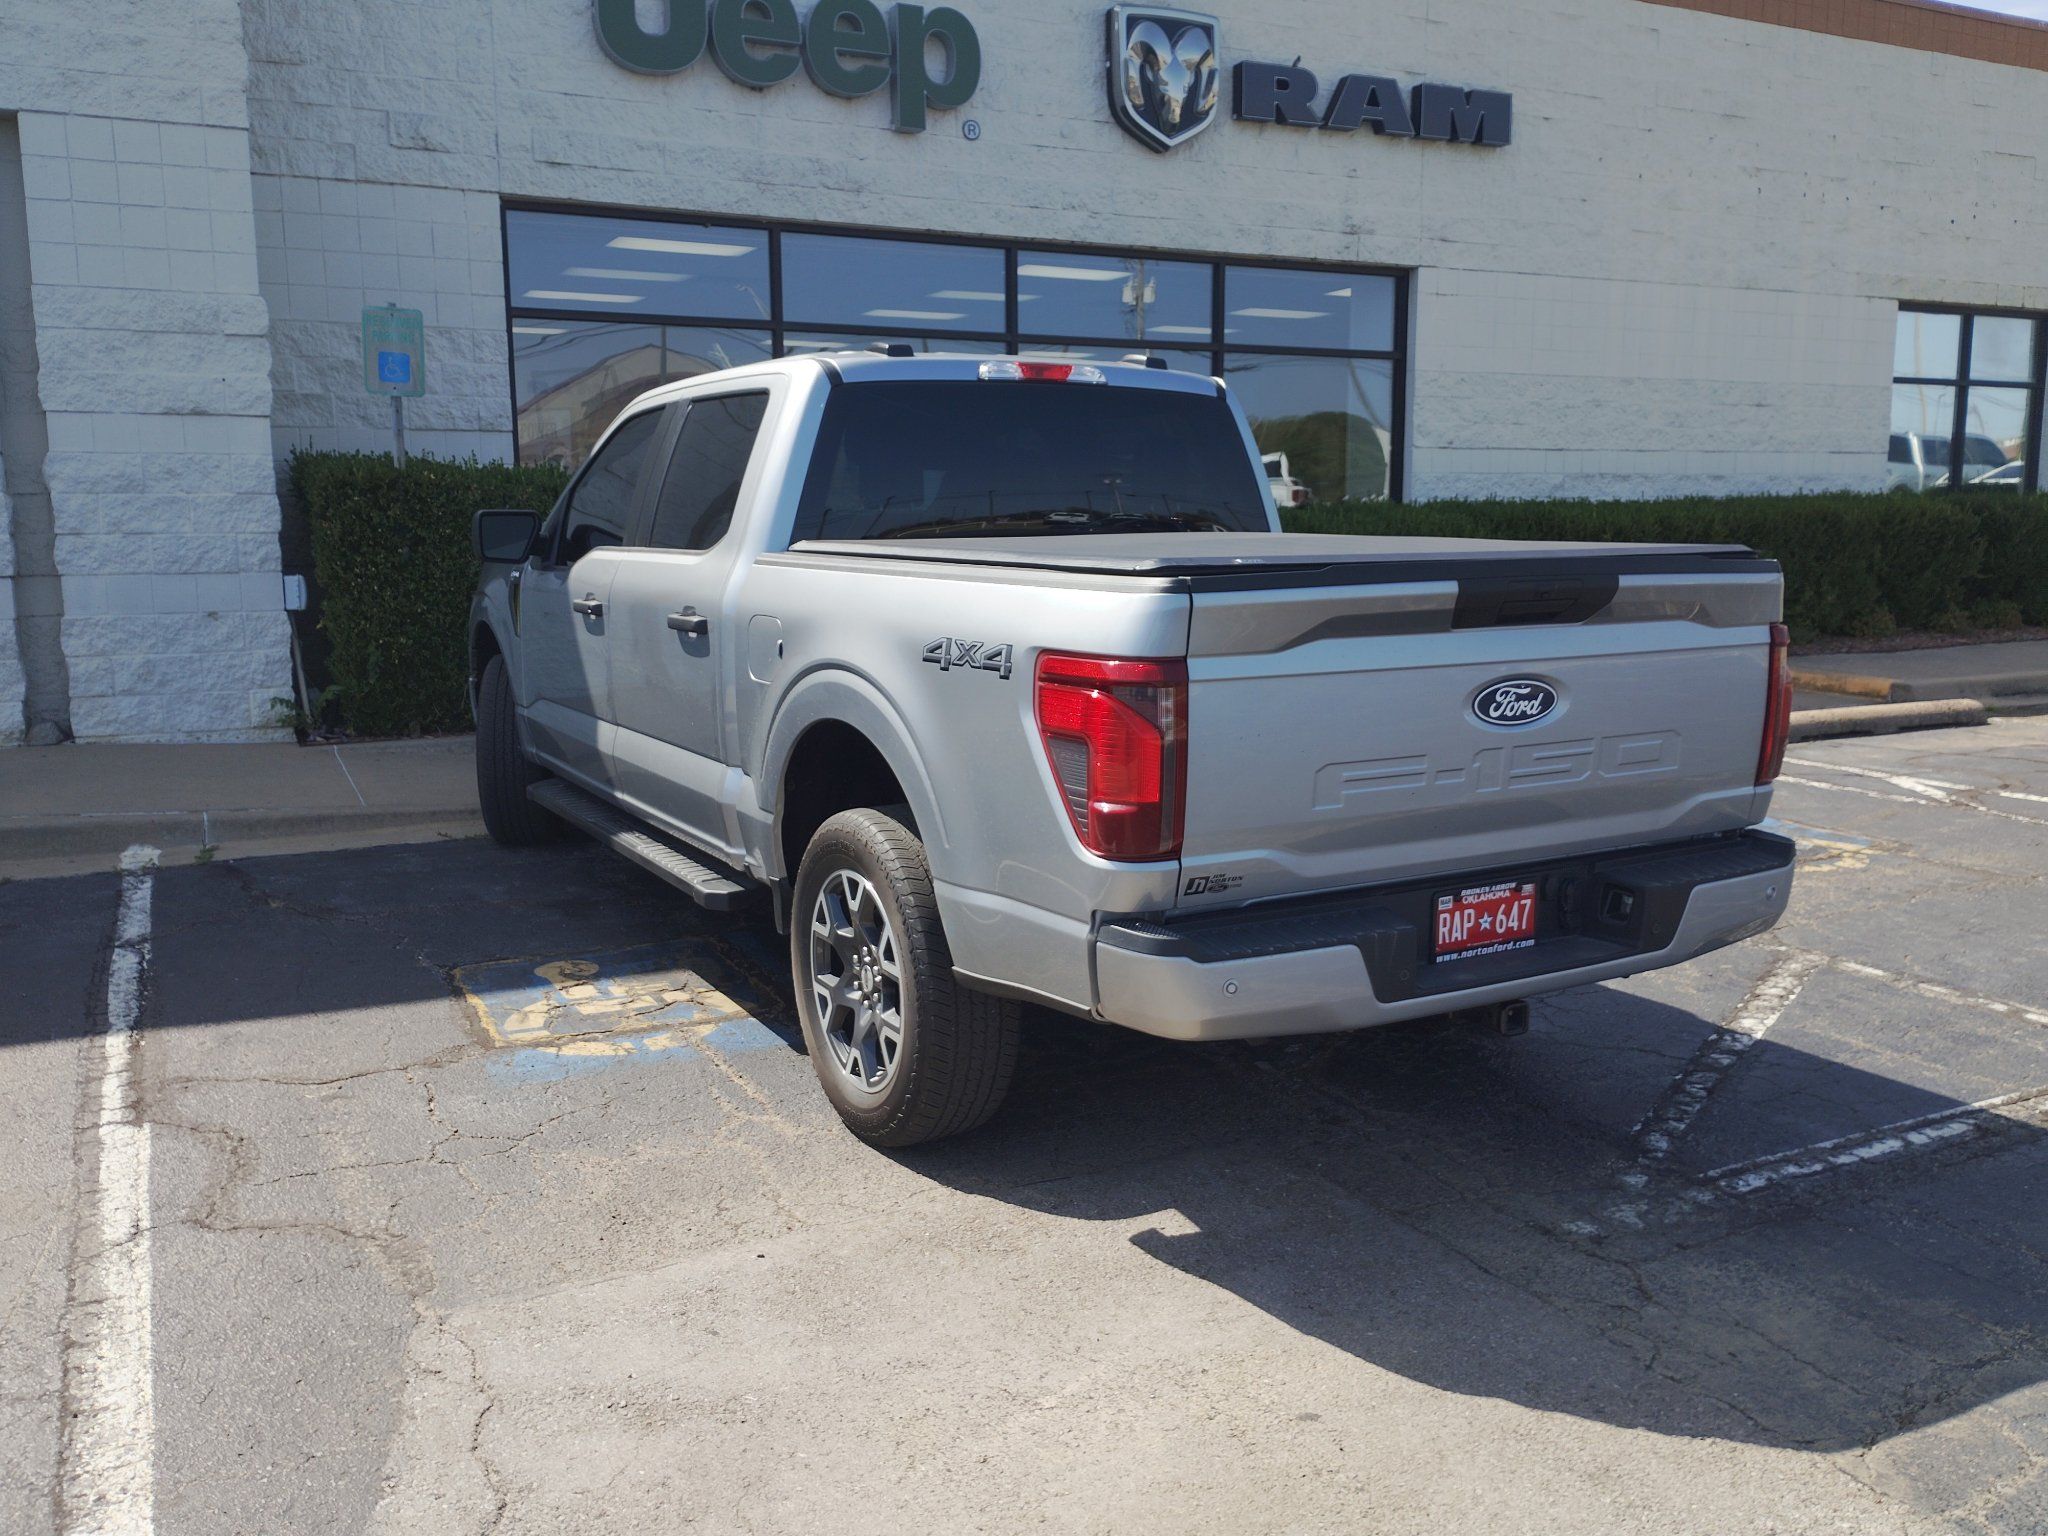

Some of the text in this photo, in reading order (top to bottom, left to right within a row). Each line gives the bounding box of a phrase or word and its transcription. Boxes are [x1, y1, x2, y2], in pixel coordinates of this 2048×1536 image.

[1232, 60, 1513, 147] RAM
[1488, 686, 1545, 719] Ford
[1311, 729, 1682, 811] F-150
[1461, 886, 1490, 896] BROKEN
[1491, 882, 1517, 892] ARROW
[1462, 890, 1510, 904] OKLAHOMA
[1439, 899, 1531, 944] RAP 647
[1436, 939, 1535, 963] www.nortonford.com
